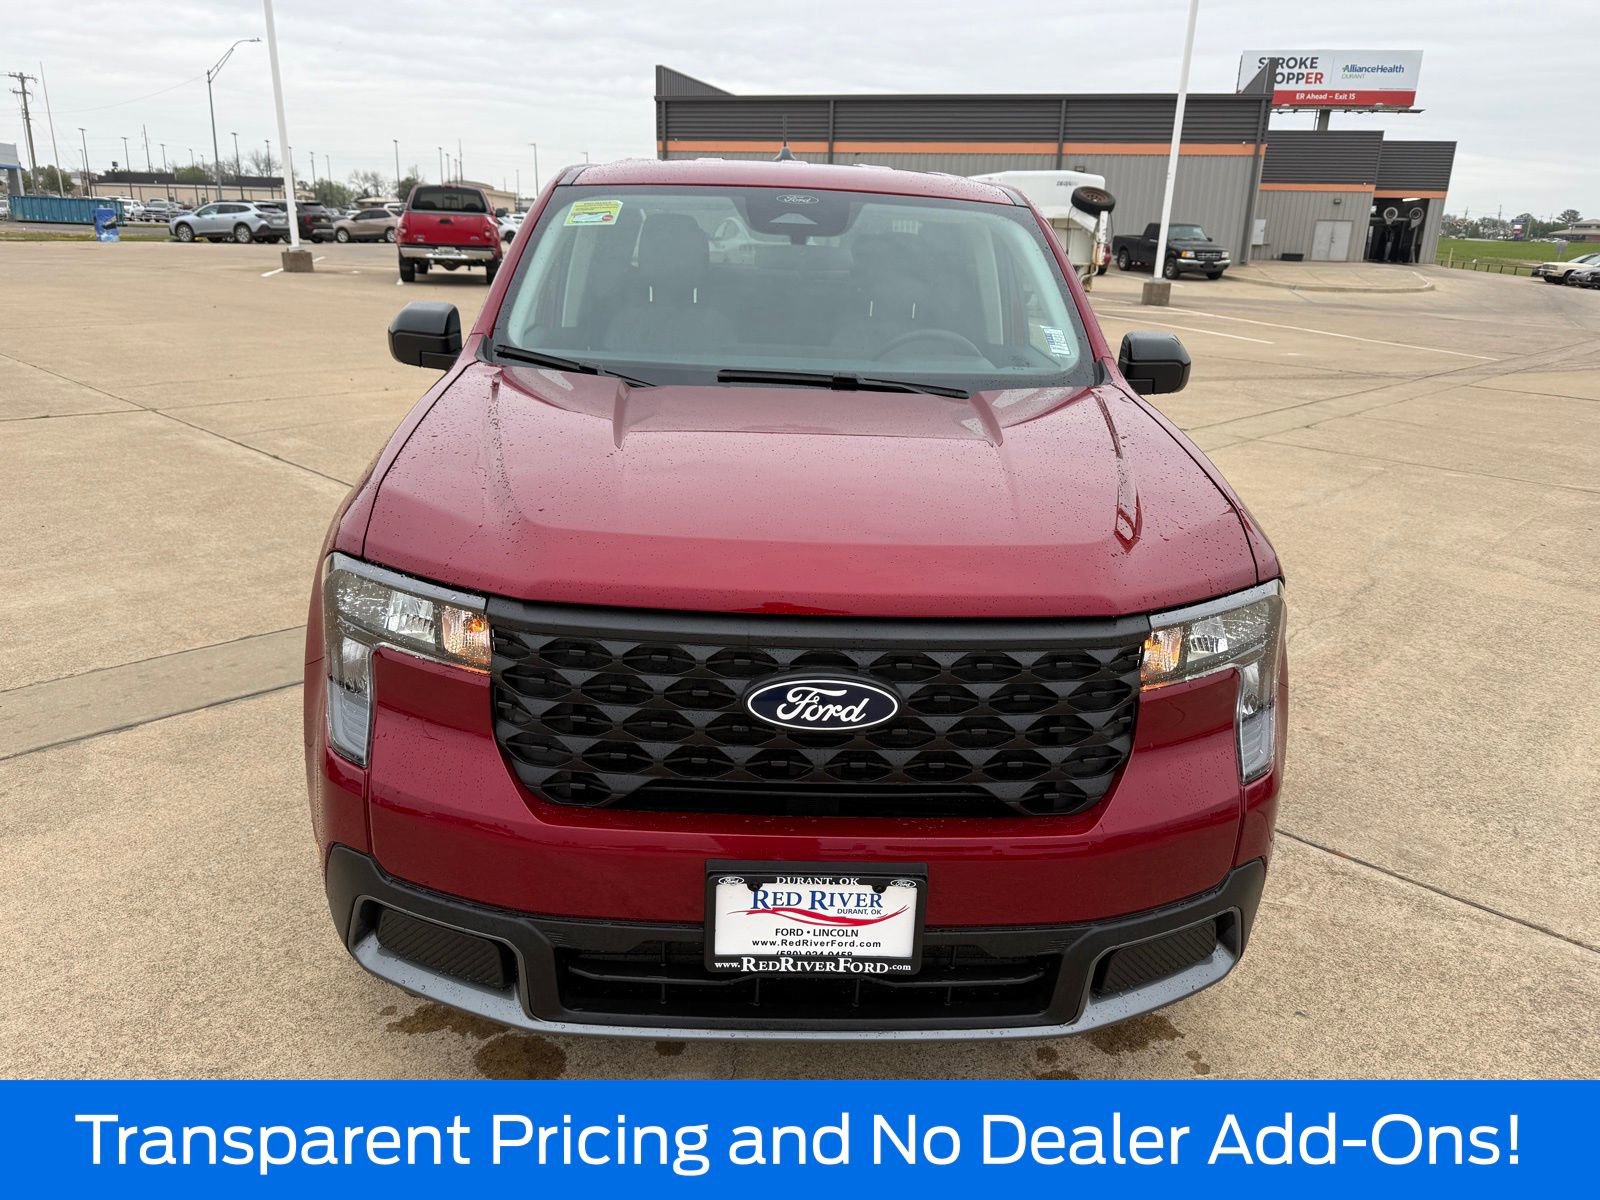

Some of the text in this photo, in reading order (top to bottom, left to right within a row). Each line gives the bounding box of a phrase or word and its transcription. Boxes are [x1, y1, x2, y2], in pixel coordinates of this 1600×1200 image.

[1258, 56, 1319, 69] SROKE
[1342, 63, 1405, 73] AllianceHealth
[1274, 72, 1324, 85] OPPER
[1295, 92, 1306, 101] ER
[1306, 92, 1328, 101] Ahead
[1334, 92, 1348, 101] Exit
[776, 686, 871, 723] Ford
[776, 876, 860, 886] DURANT, OK
[750, 889, 884, 911] RED RIVER
[836, 908, 869, 916] DURANT,
[774, 927, 860, 938] FORD LINCOLN
[751, 938, 882, 949] www.RedRiverFord.com
